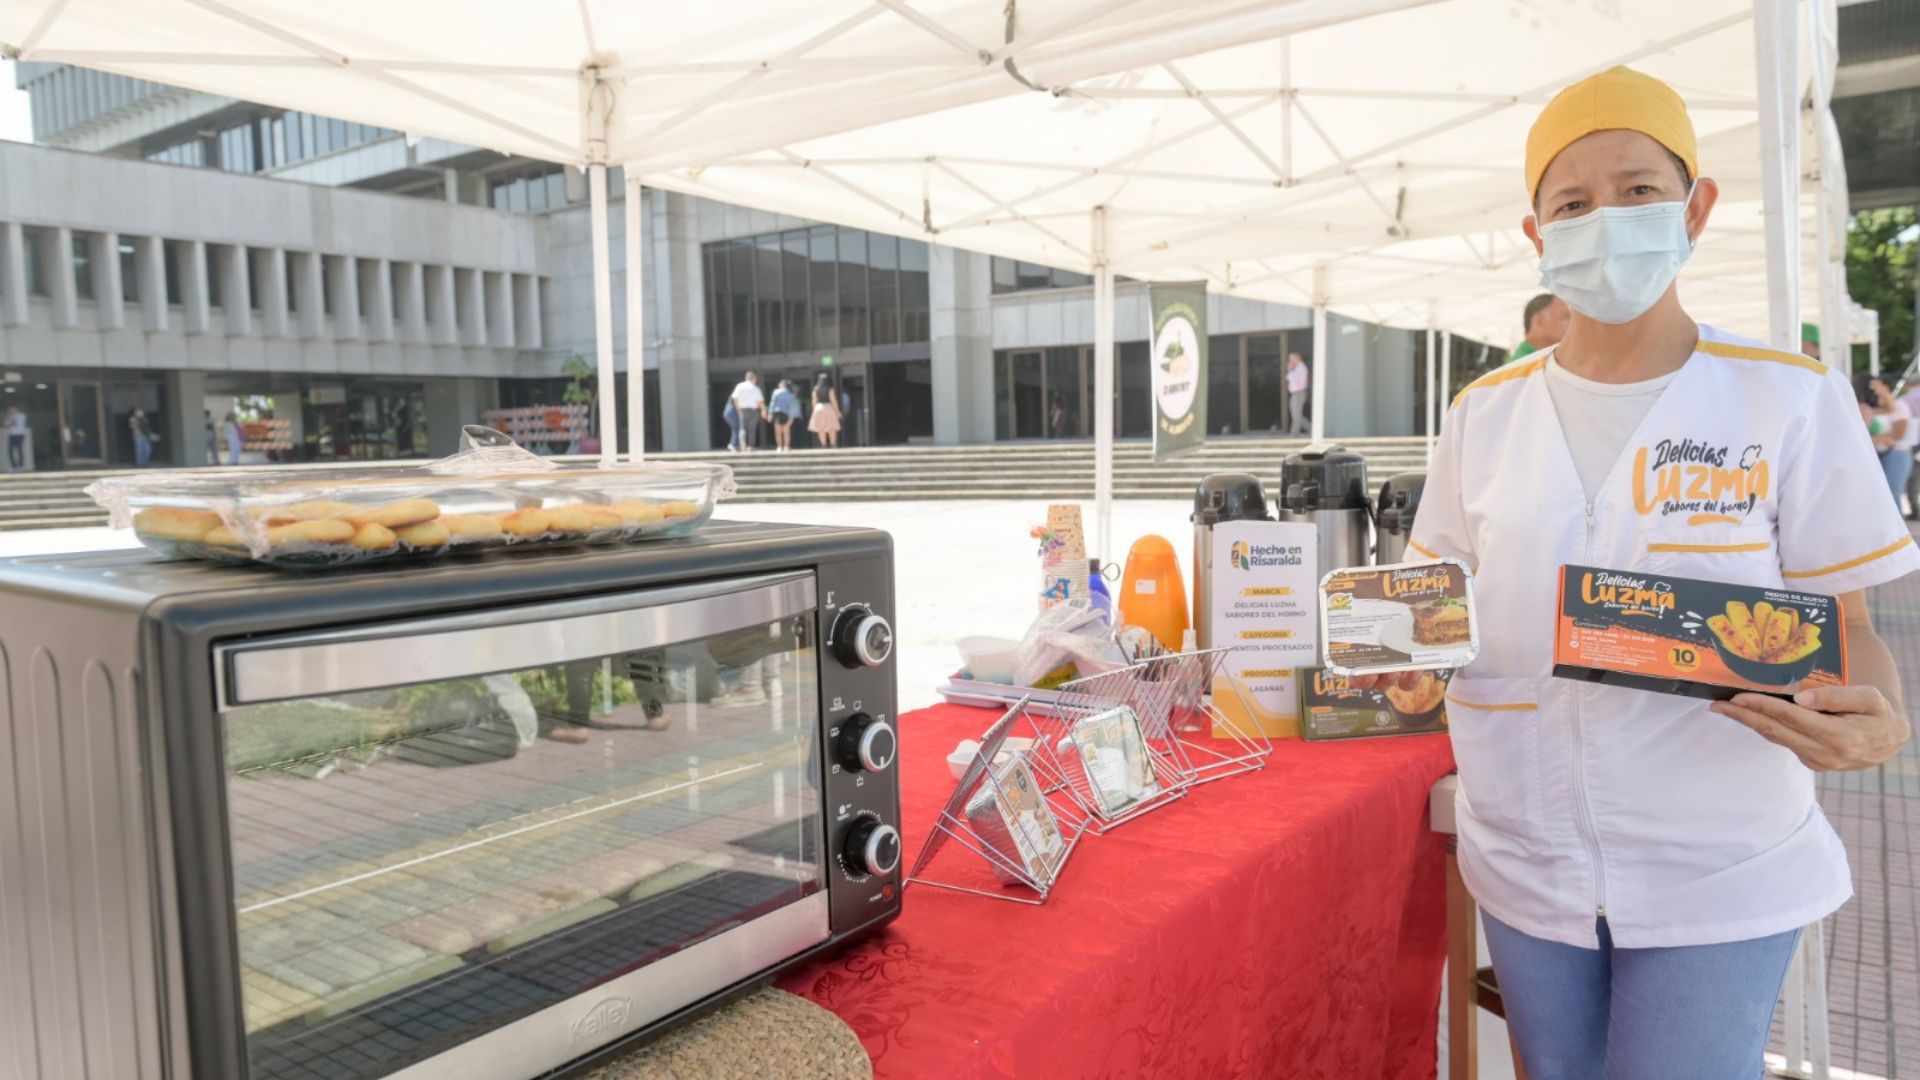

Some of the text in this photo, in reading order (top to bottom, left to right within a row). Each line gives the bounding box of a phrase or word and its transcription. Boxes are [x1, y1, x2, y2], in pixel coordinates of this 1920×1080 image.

[1652, 438, 1729, 471] Delicias
[1632, 446, 1770, 515] Luzma
[1662, 500, 1701, 515] Sabores
[1703, 500, 1718, 512] del
[1250, 545, 1302, 555] Hecho en
[1250, 555, 1302, 566] Risaralda
[1392, 568, 1428, 581] Delicias
[1595, 572, 1647, 589] Delicias
[1383, 573, 1451, 598] Luzma
[1582, 573, 1675, 609] Luzma
[1262, 643, 1314, 651] PROCESADOS
[1672, 648, 1696, 664] 10
